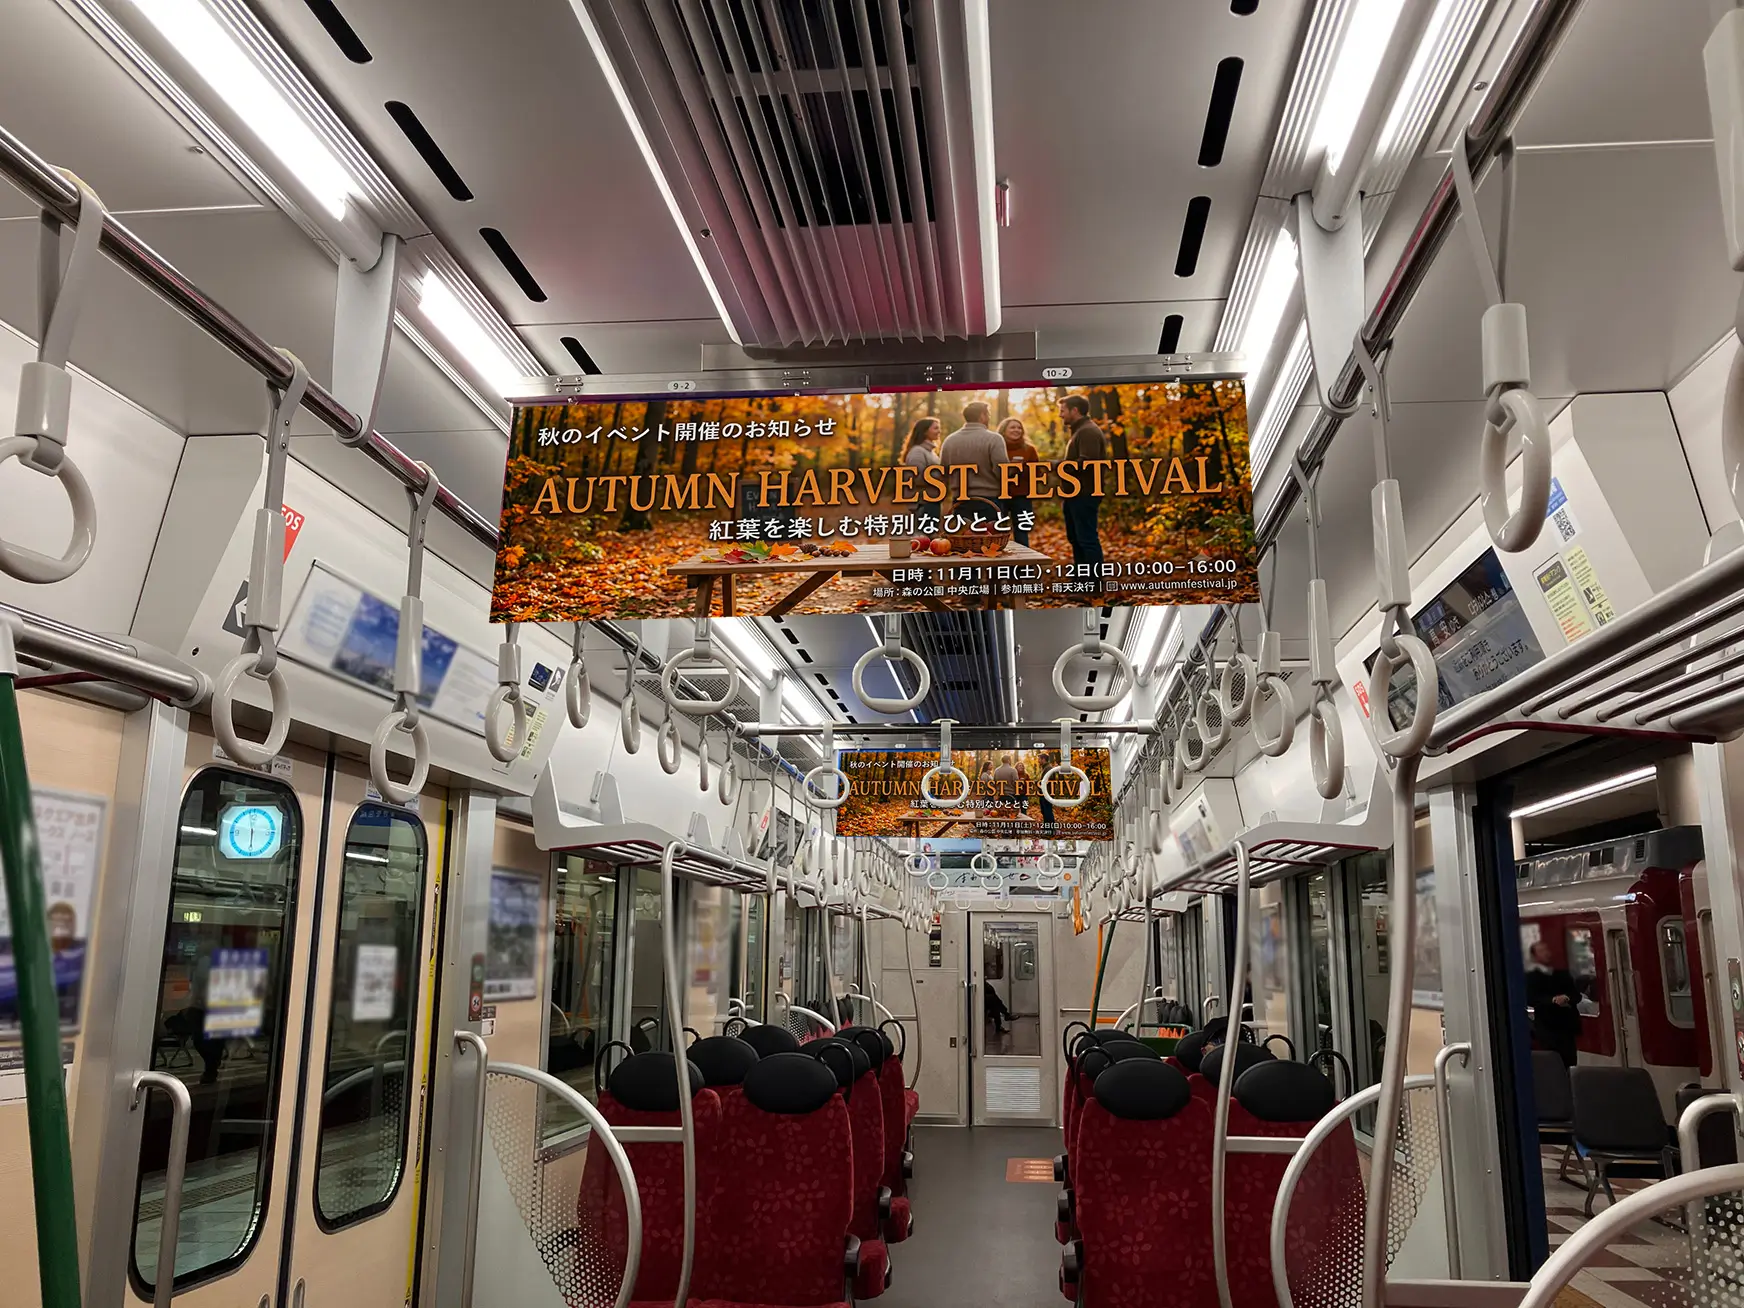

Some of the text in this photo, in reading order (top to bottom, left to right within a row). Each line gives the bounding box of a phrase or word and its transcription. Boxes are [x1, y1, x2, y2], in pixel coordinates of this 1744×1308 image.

[537, 417, 837, 447] 秋のイベント開催のお知らせ
[530, 456, 1223, 514] AUTUMN HARVEST FESTIVAL
[708, 509, 1036, 541] 紅葉を楽しむ特別なひととき
[1120, 578, 1238, 591] www.autumnfestival.jp
[849, 780, 920, 796] AUTUMN
[1014, 780, 1101, 797] FESTIVL
